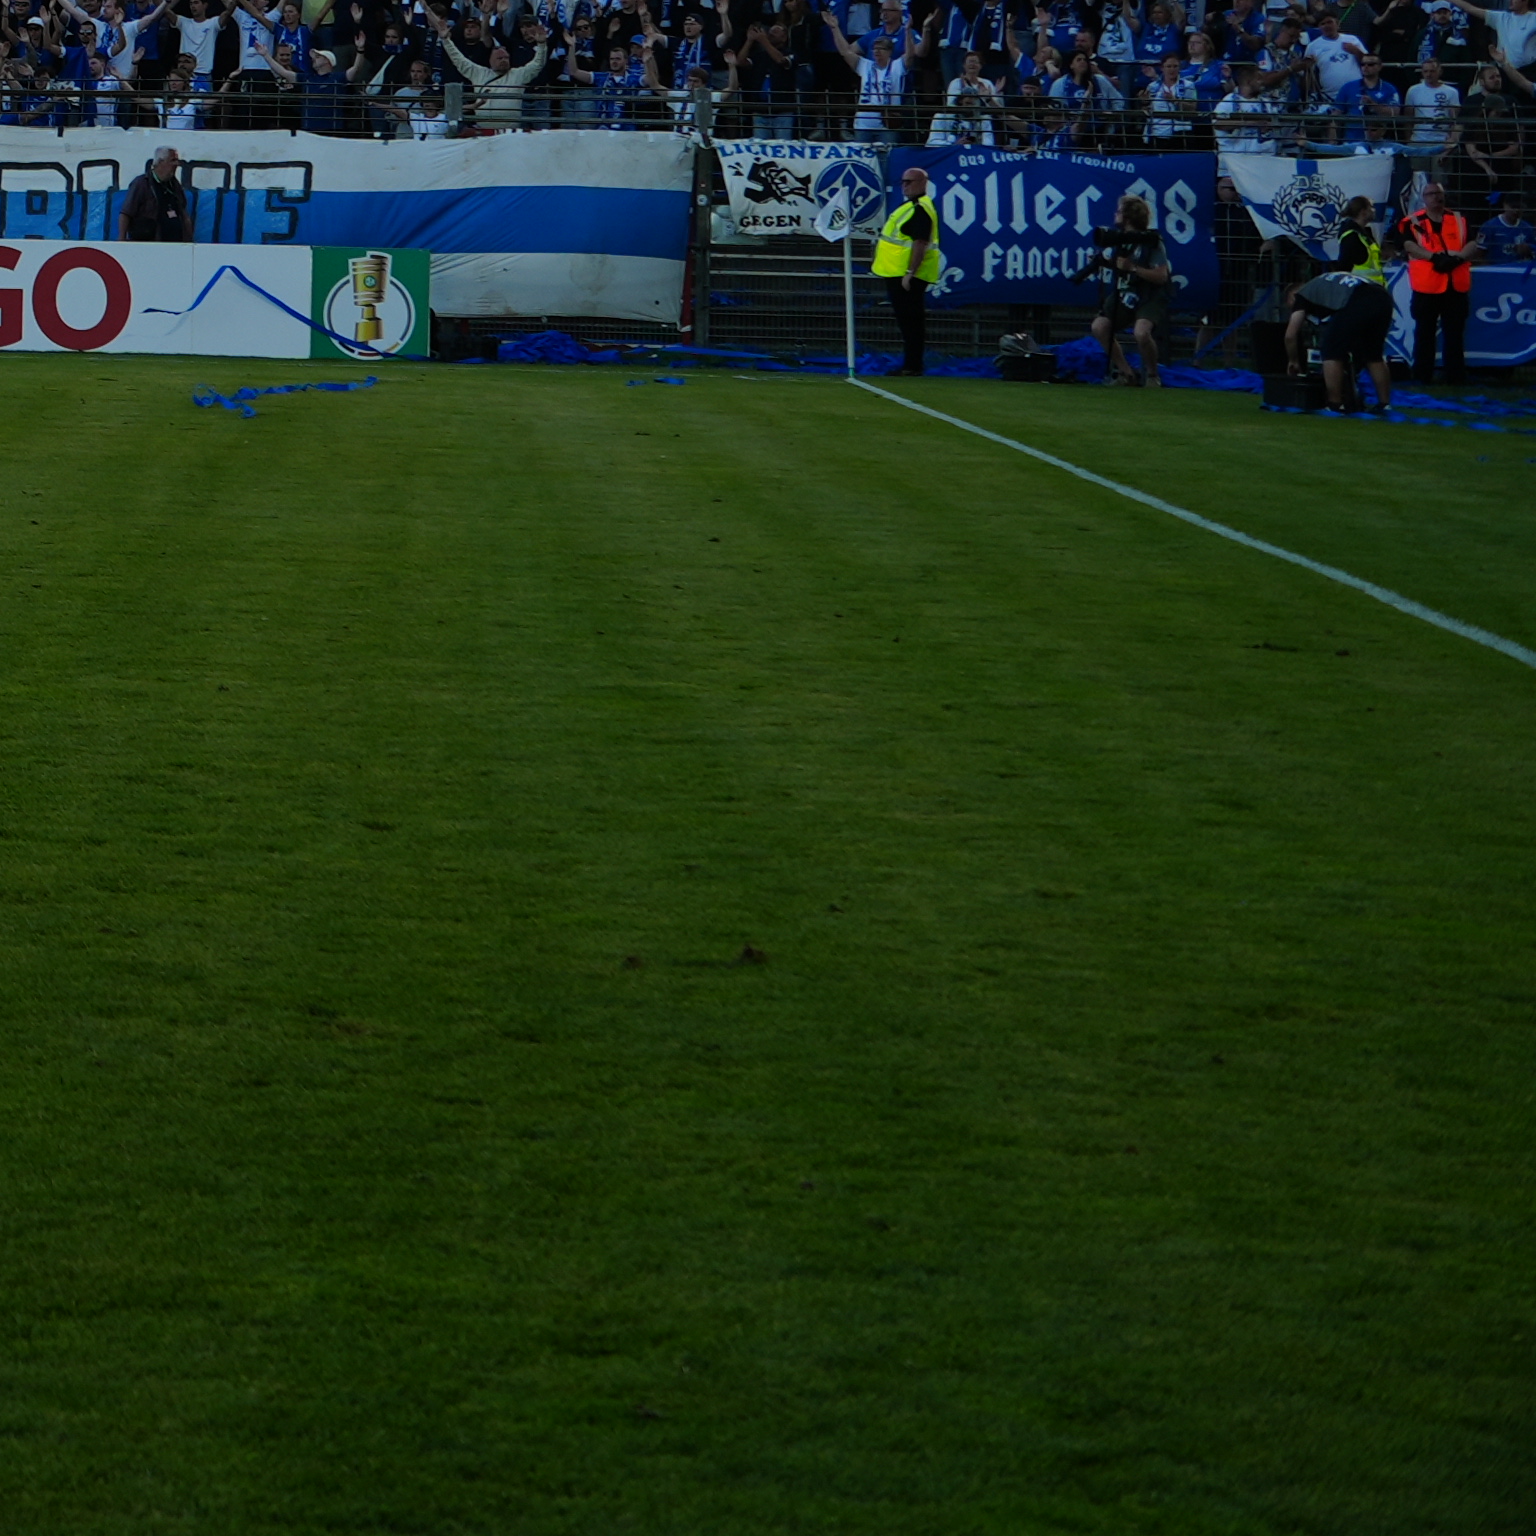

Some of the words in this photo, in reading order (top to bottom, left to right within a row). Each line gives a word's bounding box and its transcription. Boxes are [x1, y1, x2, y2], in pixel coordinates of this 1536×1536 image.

[716, 144, 877, 159] LILIENFANS
[926, 170, 1104, 238] öller
[740, 214, 801, 228] GEGEN
